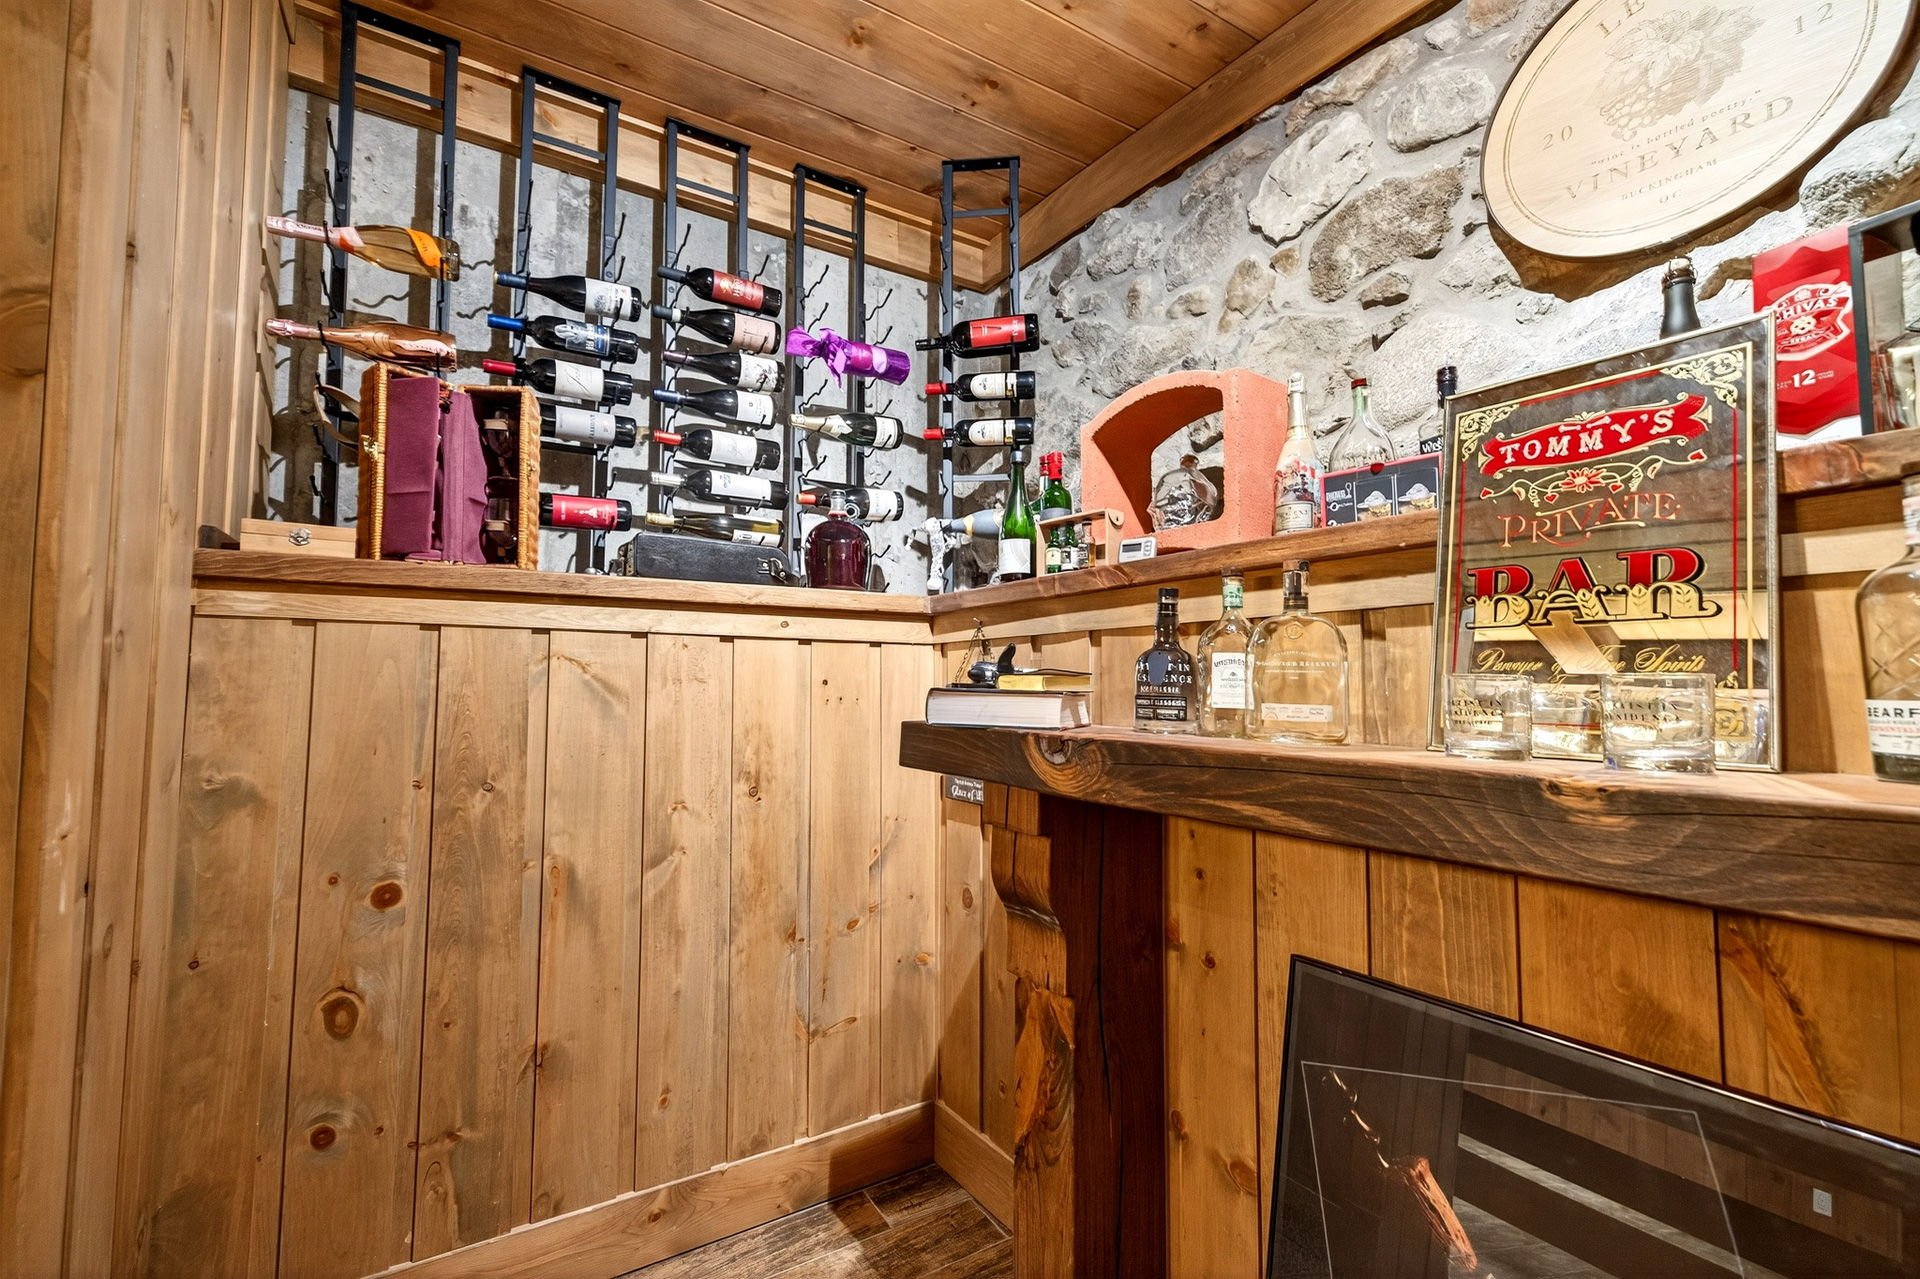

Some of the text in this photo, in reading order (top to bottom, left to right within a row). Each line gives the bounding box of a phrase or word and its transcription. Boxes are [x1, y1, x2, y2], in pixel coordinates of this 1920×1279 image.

[1542, 2, 1833, 150] 20 12
[1564, 95, 1796, 199] VINEYARD
[1621, 158, 1718, 201] BUCKINGHAM
[1792, 369, 1816, 389] 12
[1499, 407, 1675, 464] TOMMY'S
[1498, 493, 1678, 548] PRIVATE
[1465, 547, 1723, 630] BAR
[1634, 643, 1706, 672] Spirits
